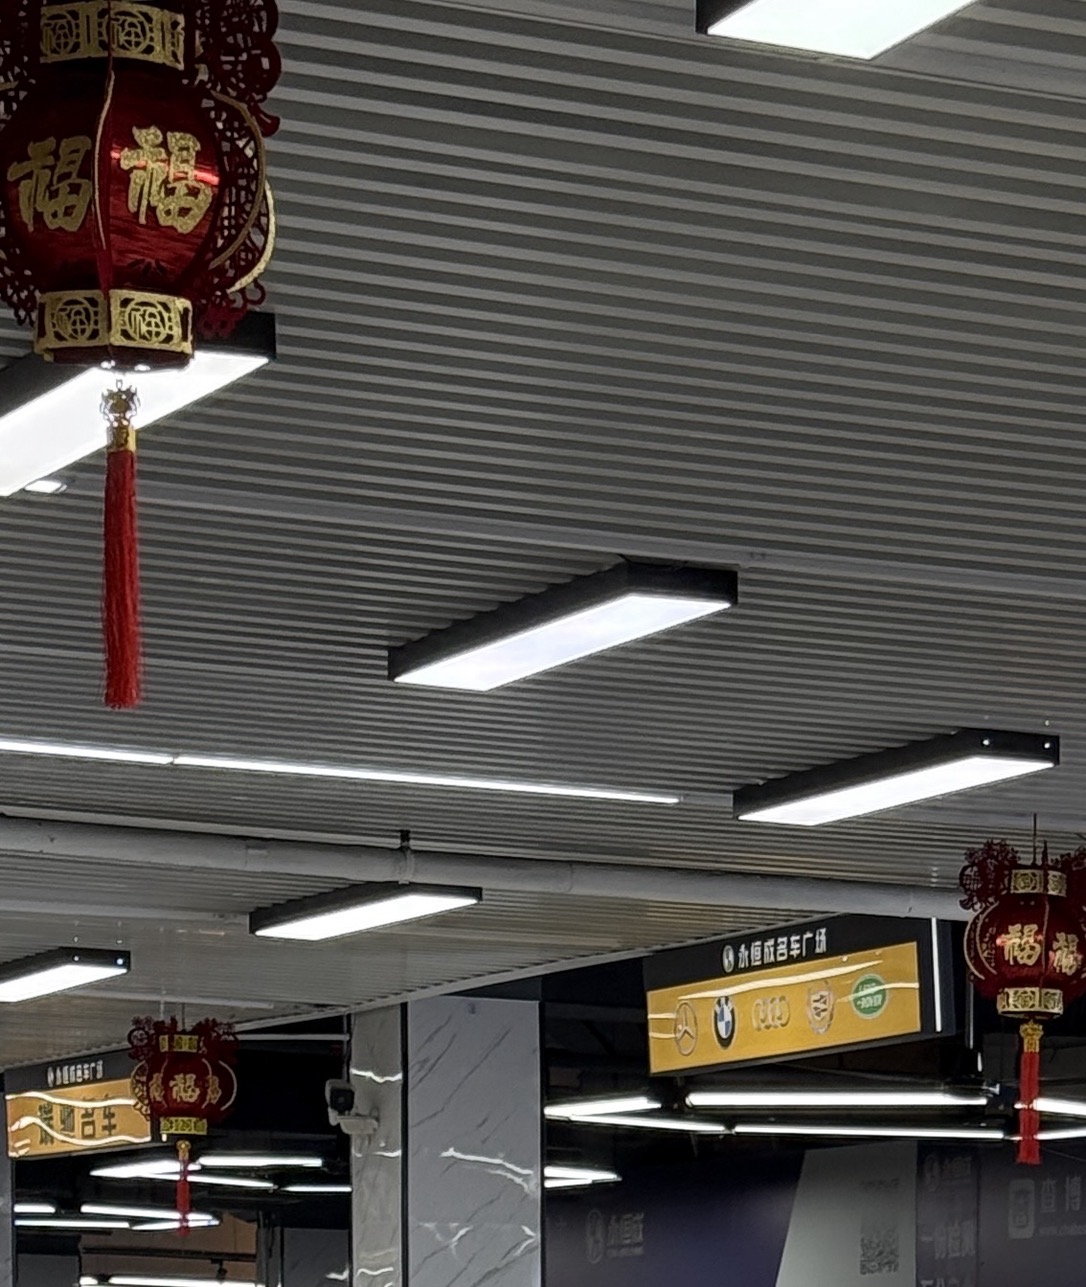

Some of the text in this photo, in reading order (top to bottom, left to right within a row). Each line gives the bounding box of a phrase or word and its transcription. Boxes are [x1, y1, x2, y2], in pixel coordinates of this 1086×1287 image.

[7, 135, 92, 232] 福
[120, 126, 213, 234] 福
[738, 927, 827, 969] 永恒成名车广场
[998, 923, 1042, 966] 福
